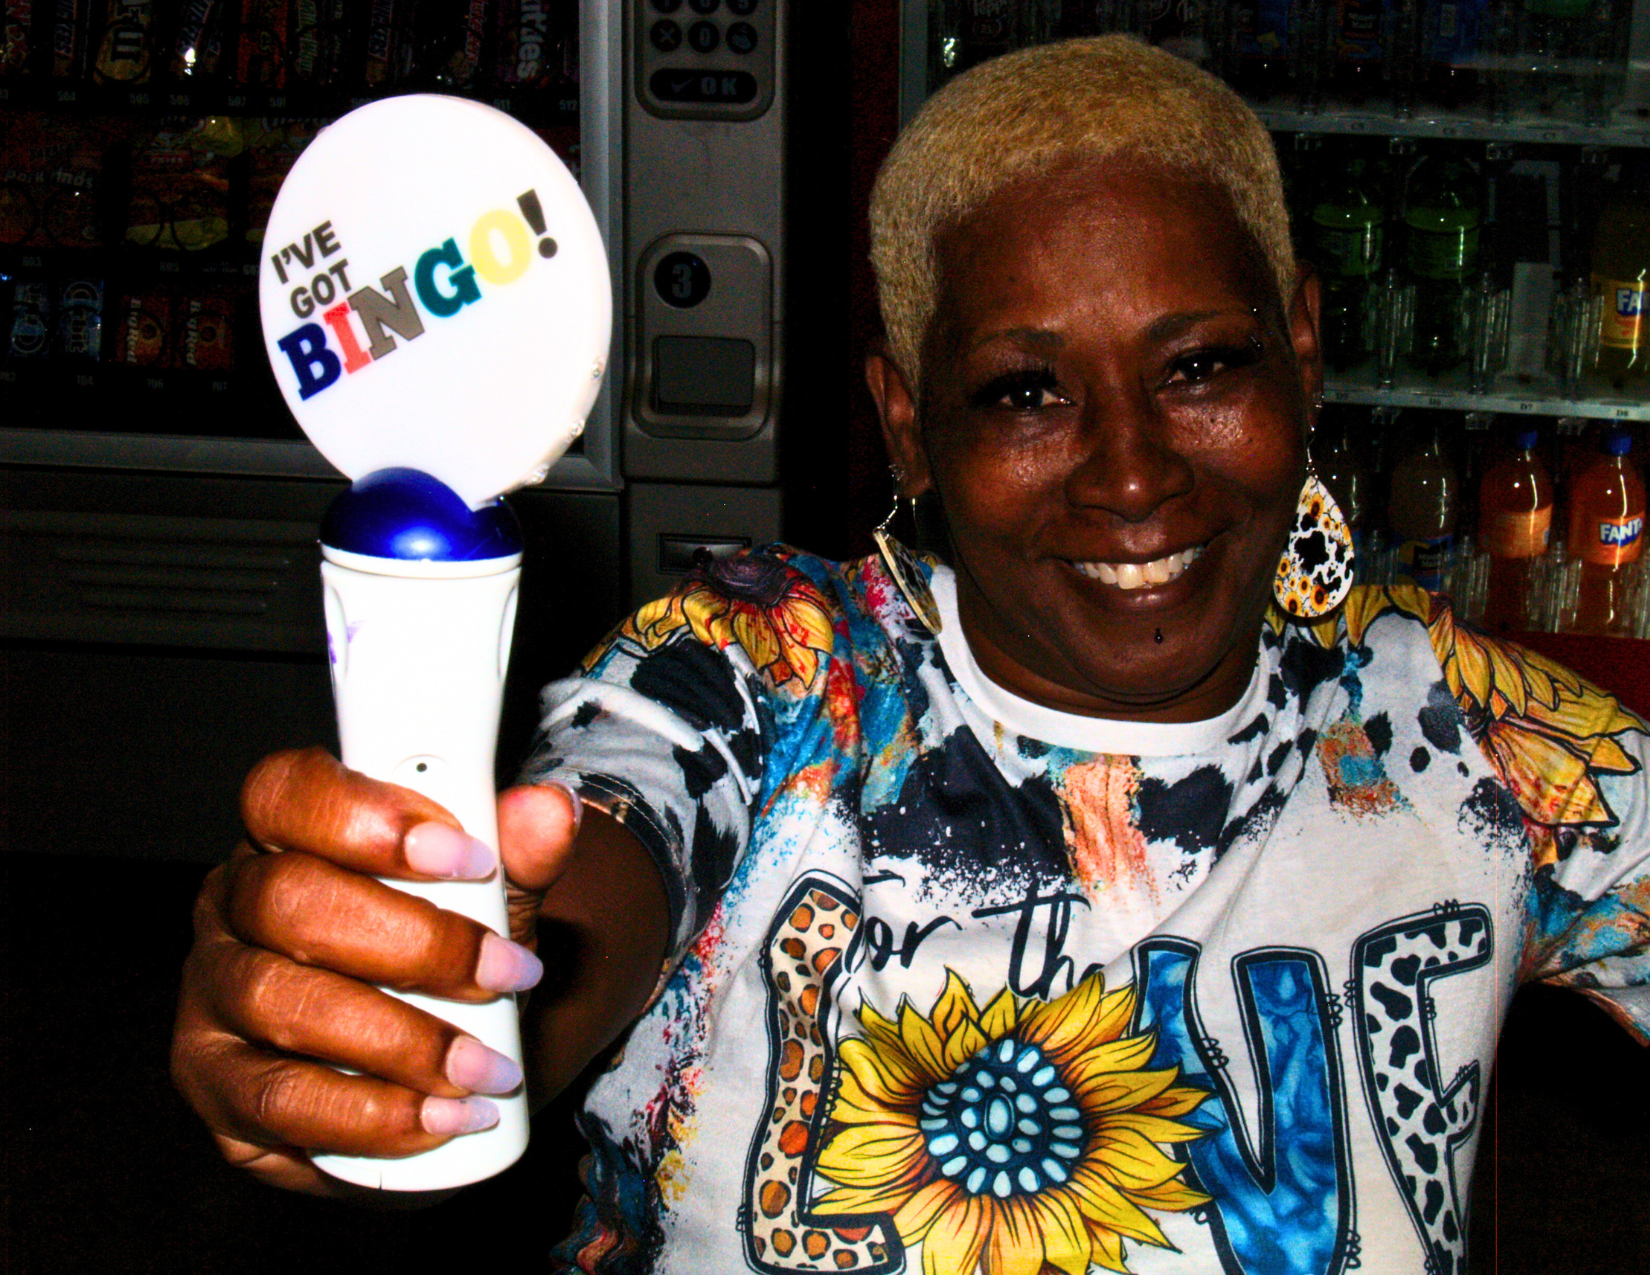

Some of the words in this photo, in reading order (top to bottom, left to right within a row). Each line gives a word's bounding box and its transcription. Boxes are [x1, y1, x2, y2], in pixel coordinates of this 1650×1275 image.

[516, 0, 548, 79] ittles
[700, 76, 738, 96] OK
[271, 219, 342, 285] I'VE
[670, 263, 693, 299] 3
[277, 188, 558, 401] BINGO!
[289, 259, 351, 319] GOT
[1617, 289, 1650, 312] FA
